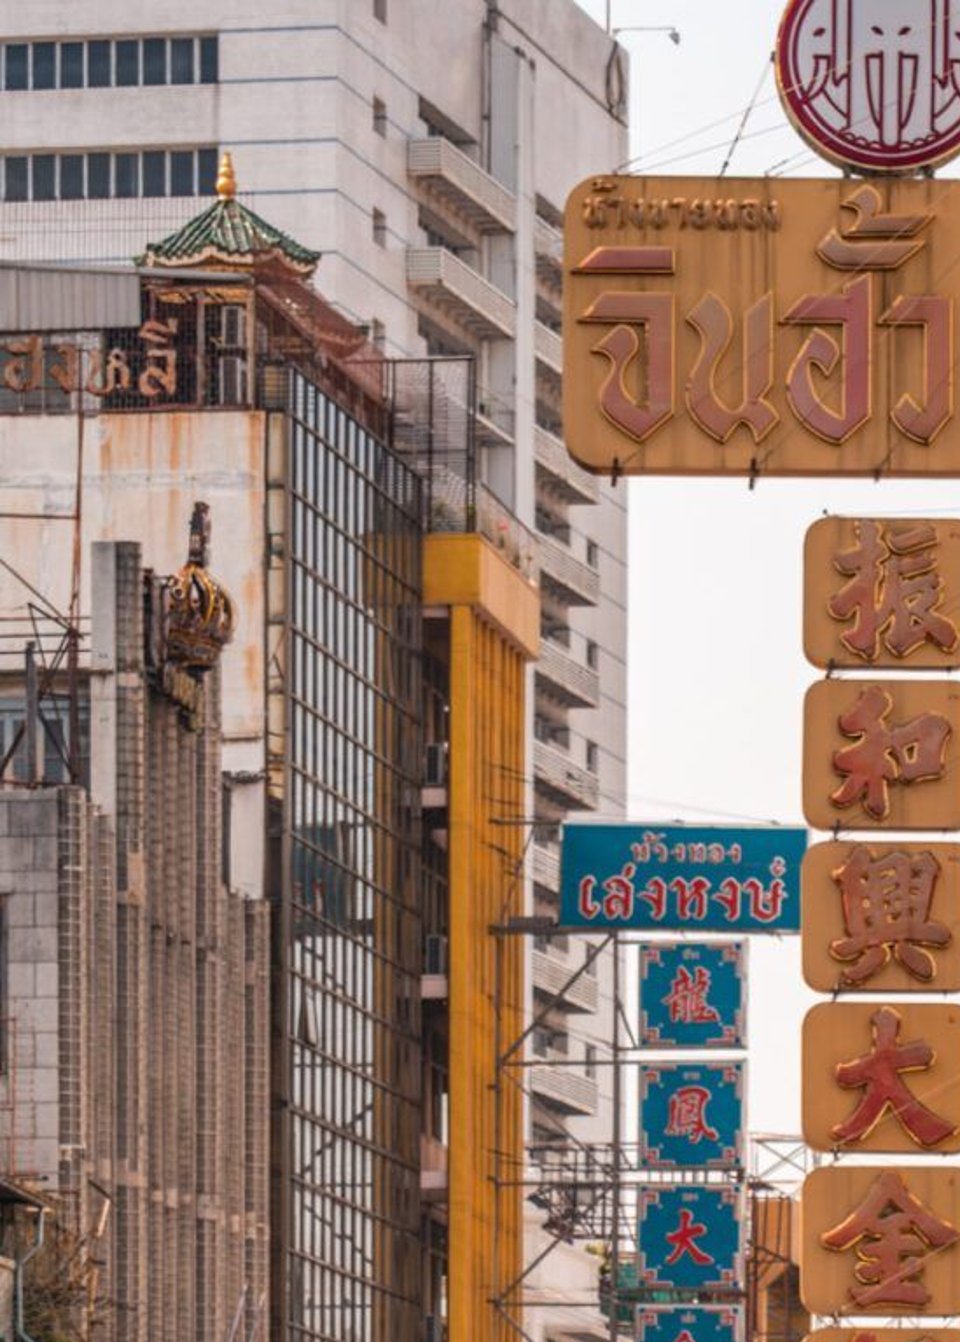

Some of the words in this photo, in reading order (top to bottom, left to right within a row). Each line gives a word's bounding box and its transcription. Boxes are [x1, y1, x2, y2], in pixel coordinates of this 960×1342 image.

[630, 831, 742, 864] ห้างทอง
[578, 856, 788, 923] เล่งหงษ์
